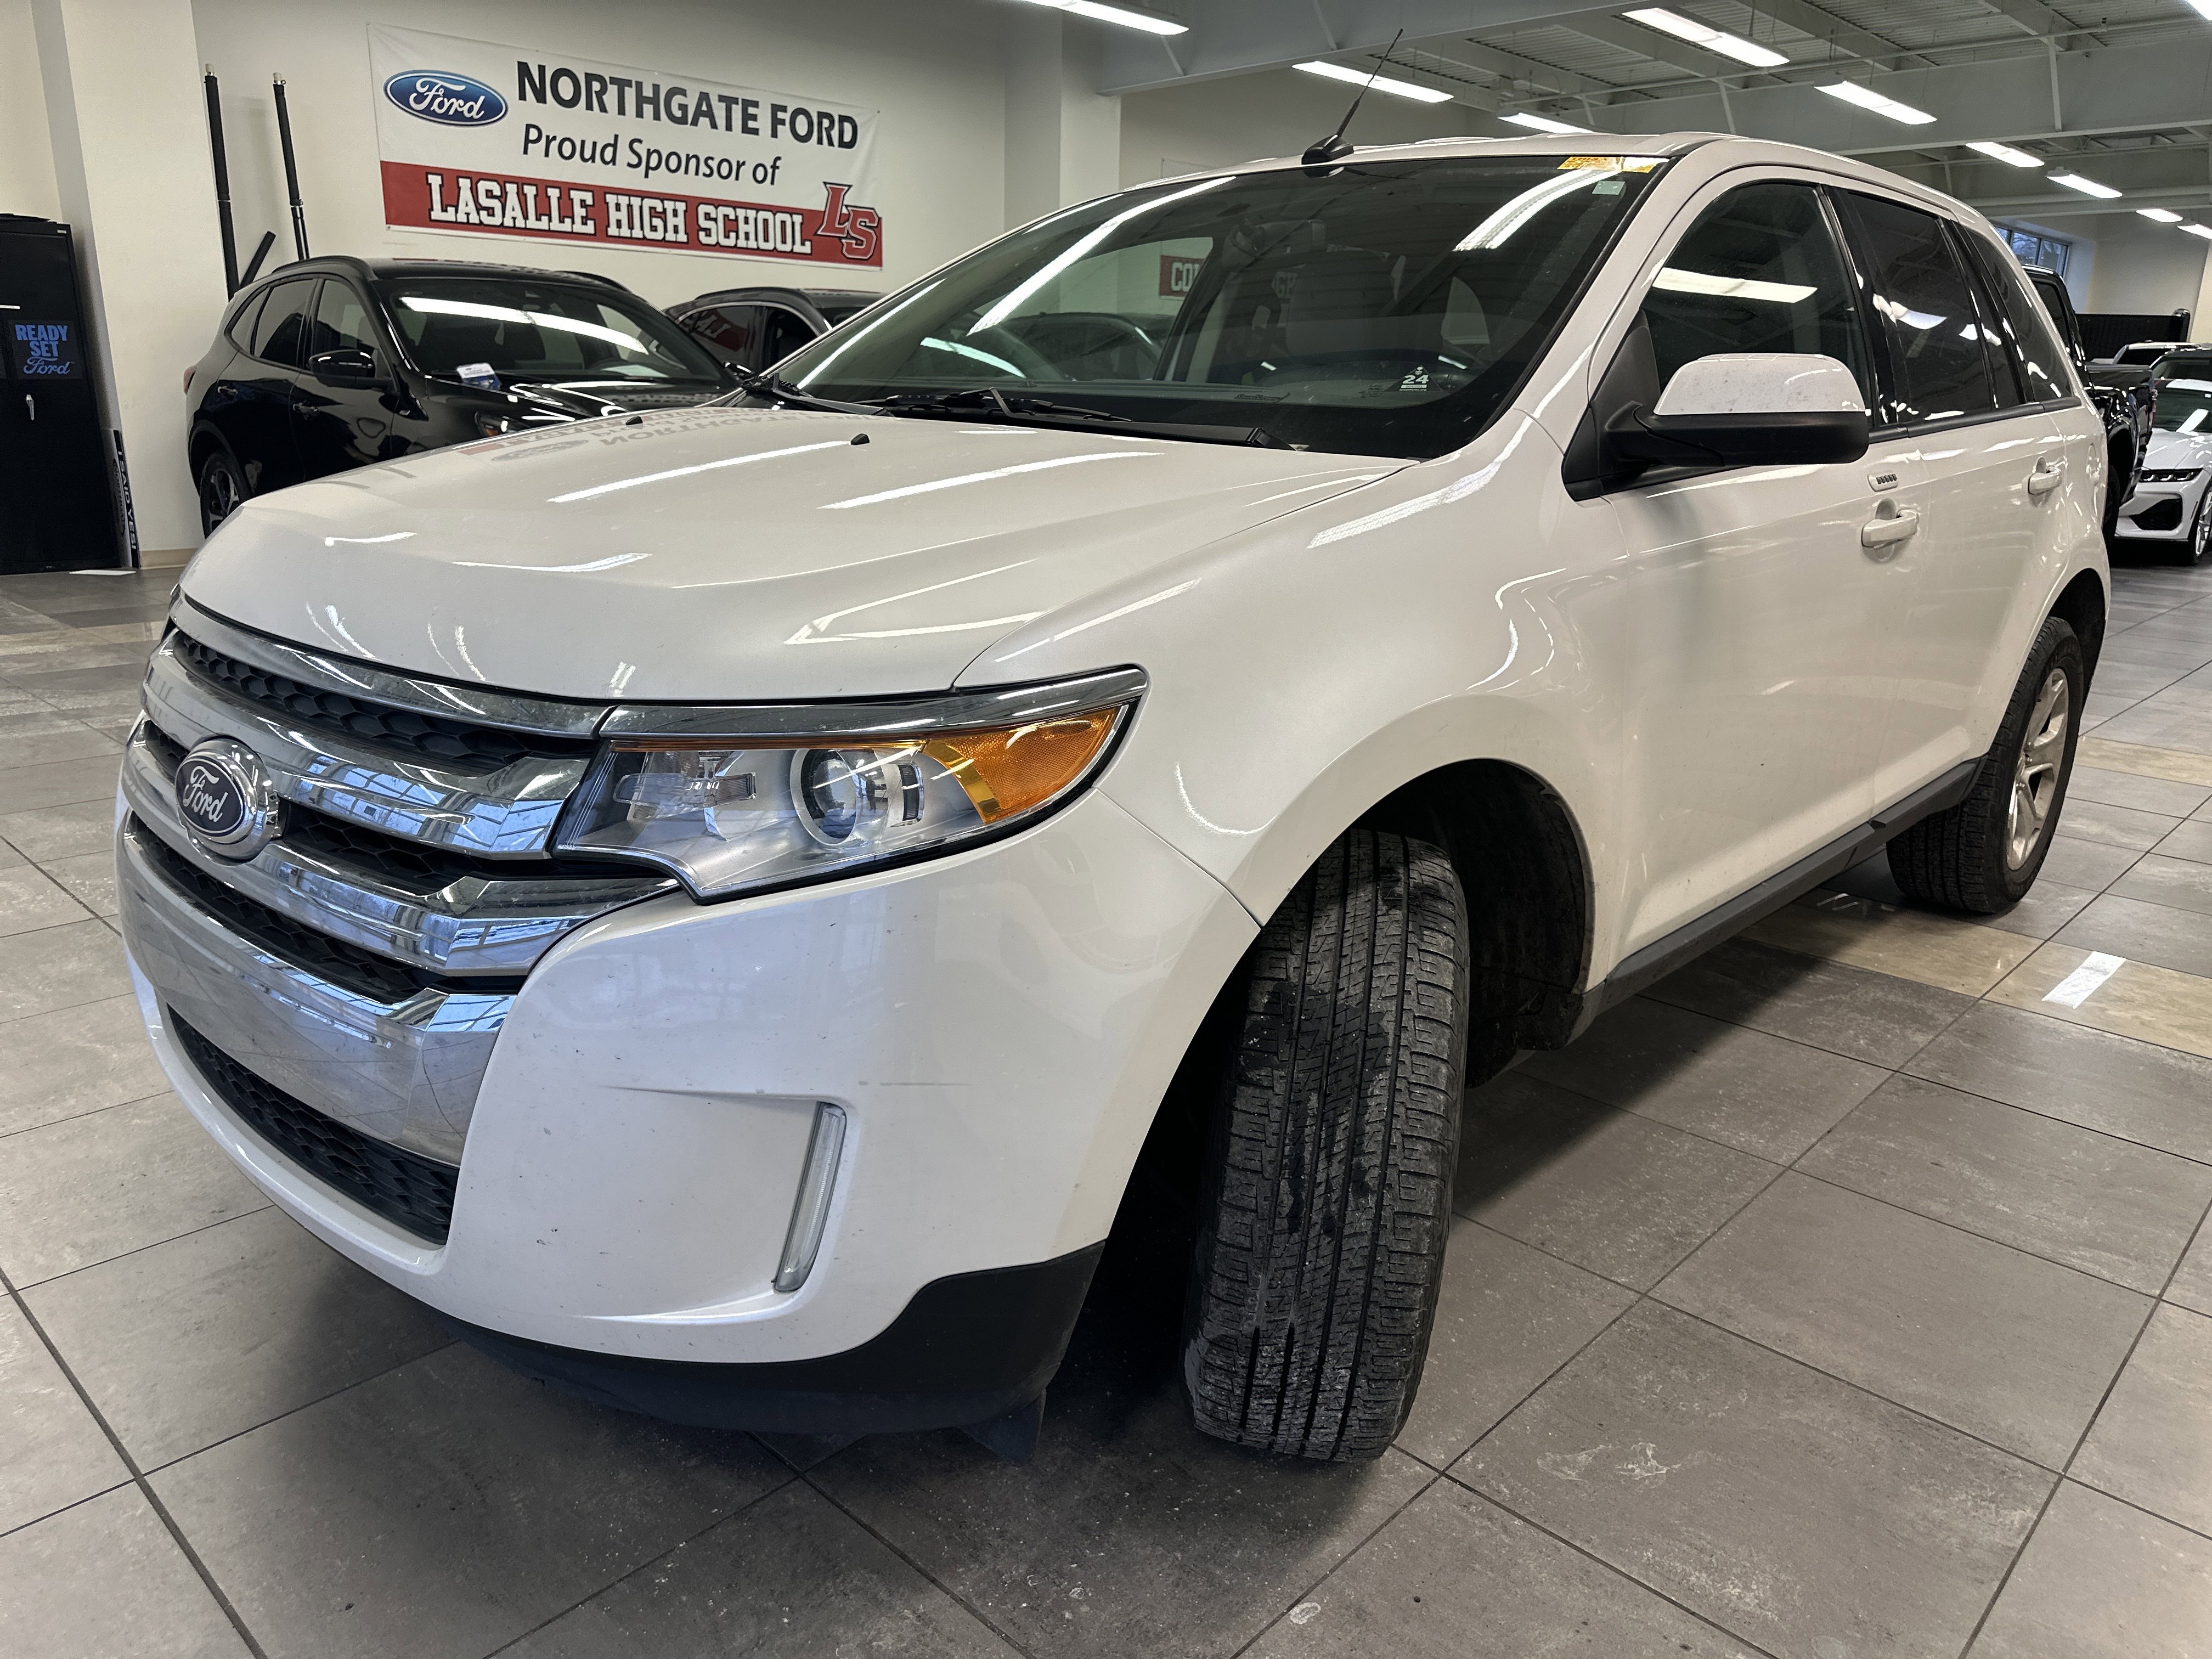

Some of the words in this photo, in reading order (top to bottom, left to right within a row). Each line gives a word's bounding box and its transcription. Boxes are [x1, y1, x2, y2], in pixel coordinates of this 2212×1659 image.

[409, 77, 486, 120] Ford
[517, 61, 760, 136] NORTHGATE
[770, 103, 859, 150] FORD
[523, 123, 619, 166] Proud
[627, 138, 746, 182] Sponsor
[752, 156, 782, 185] of
[426, 172, 596, 236] LASALLE
[605, 193, 689, 244] HIGH
[696, 203, 812, 256] SCHOOL
[814, 182, 879, 260] LS
[14, 324, 67, 341] READY
[29, 341, 59, 357] SET
[23, 357, 71, 374] Ford
[1402, 375, 1429, 384] 24
[119, 460, 131, 504] SAID
[182, 765, 229, 823] Ford
